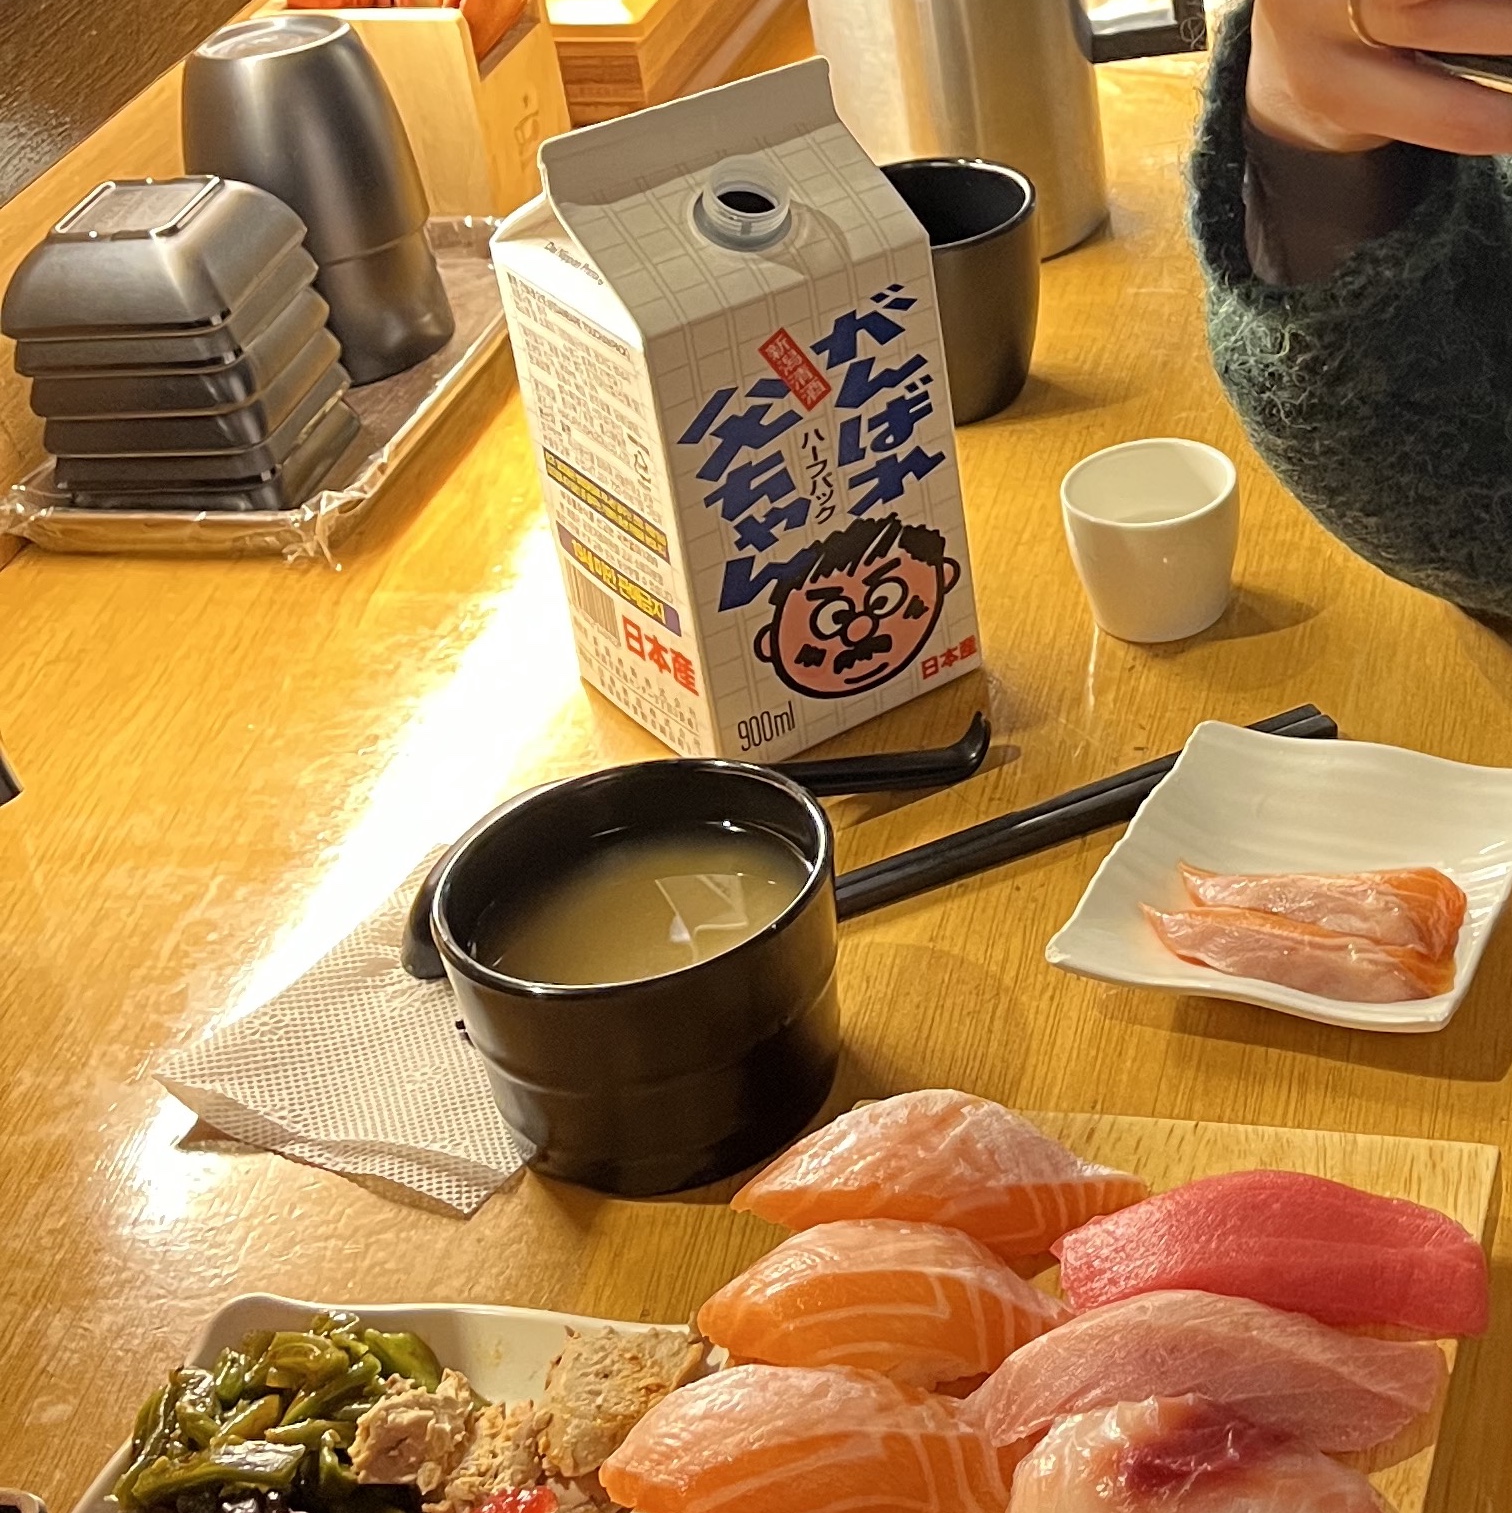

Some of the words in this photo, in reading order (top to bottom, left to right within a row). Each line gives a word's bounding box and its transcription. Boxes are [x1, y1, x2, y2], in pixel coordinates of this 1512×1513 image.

[810, 284, 946, 516] がんばれ
[677, 378, 820, 612] 父ちゃん
[622, 615, 699, 696] 日本産
[920, 635, 977, 680] 日本産
[737, 700, 796, 752] 900ml
